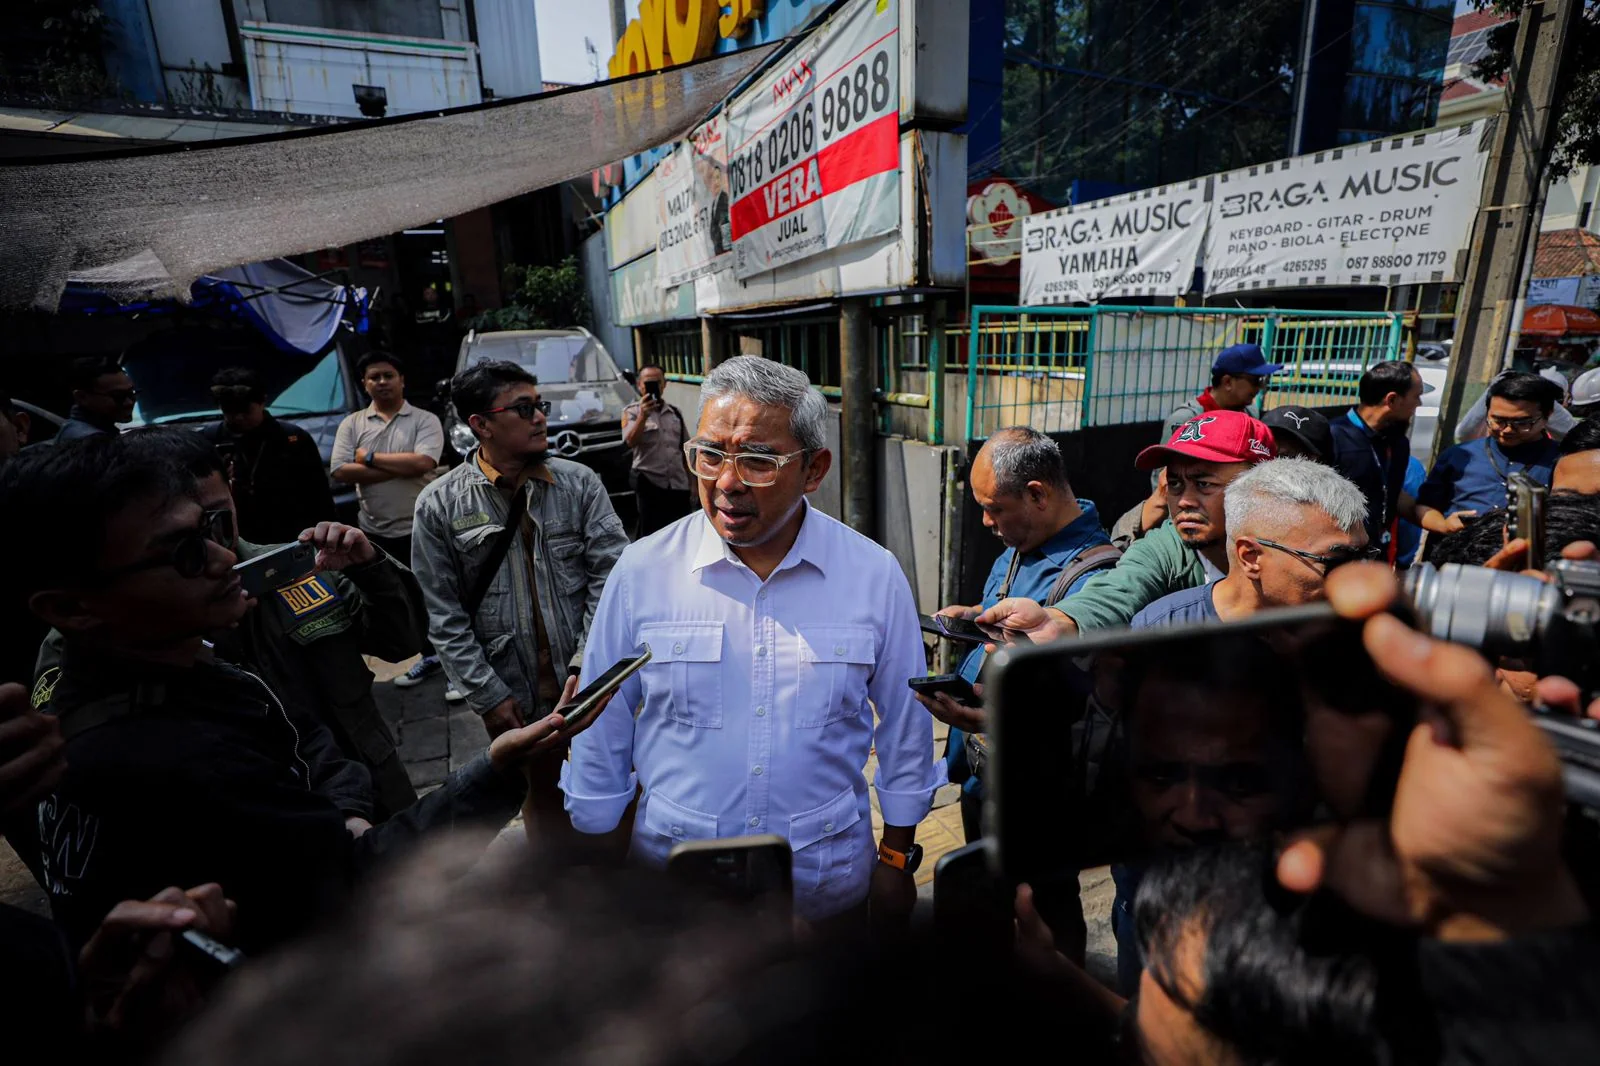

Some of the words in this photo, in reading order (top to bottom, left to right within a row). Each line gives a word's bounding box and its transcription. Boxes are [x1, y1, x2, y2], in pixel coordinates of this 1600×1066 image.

[730, 150, 764, 196] 0818
[768, 102, 814, 170] 0206
[821, 49, 891, 142] 9888
[764, 158, 822, 220] VERA
[1220, 180, 1330, 223] BRAGA
[1340, 156, 1461, 201] MUSIC
[777, 214, 808, 243] JUAL
[1026, 218, 1103, 254] BRAGA
[1110, 199, 1193, 238] MUSIC
[1228, 240, 1268, 255] PIANO
[1280, 233, 1324, 249] BIOLA
[1340, 222, 1430, 243] ELECTONE
[1230, 221, 1302, 241] KEYBOARD
[1317, 213, 1362, 230] GITAR
[1379, 205, 1433, 223] DRUM
[1059, 246, 1138, 275] YAMAHA
[1147, 271, 1172, 284] 7179
[1283, 258, 1327, 273] 4265295
[1346, 256, 1369, 270] 087
[1371, 254, 1413, 270] 88800
[1416, 250, 1447, 267] 7179
[280, 579, 331, 613] BOLD
